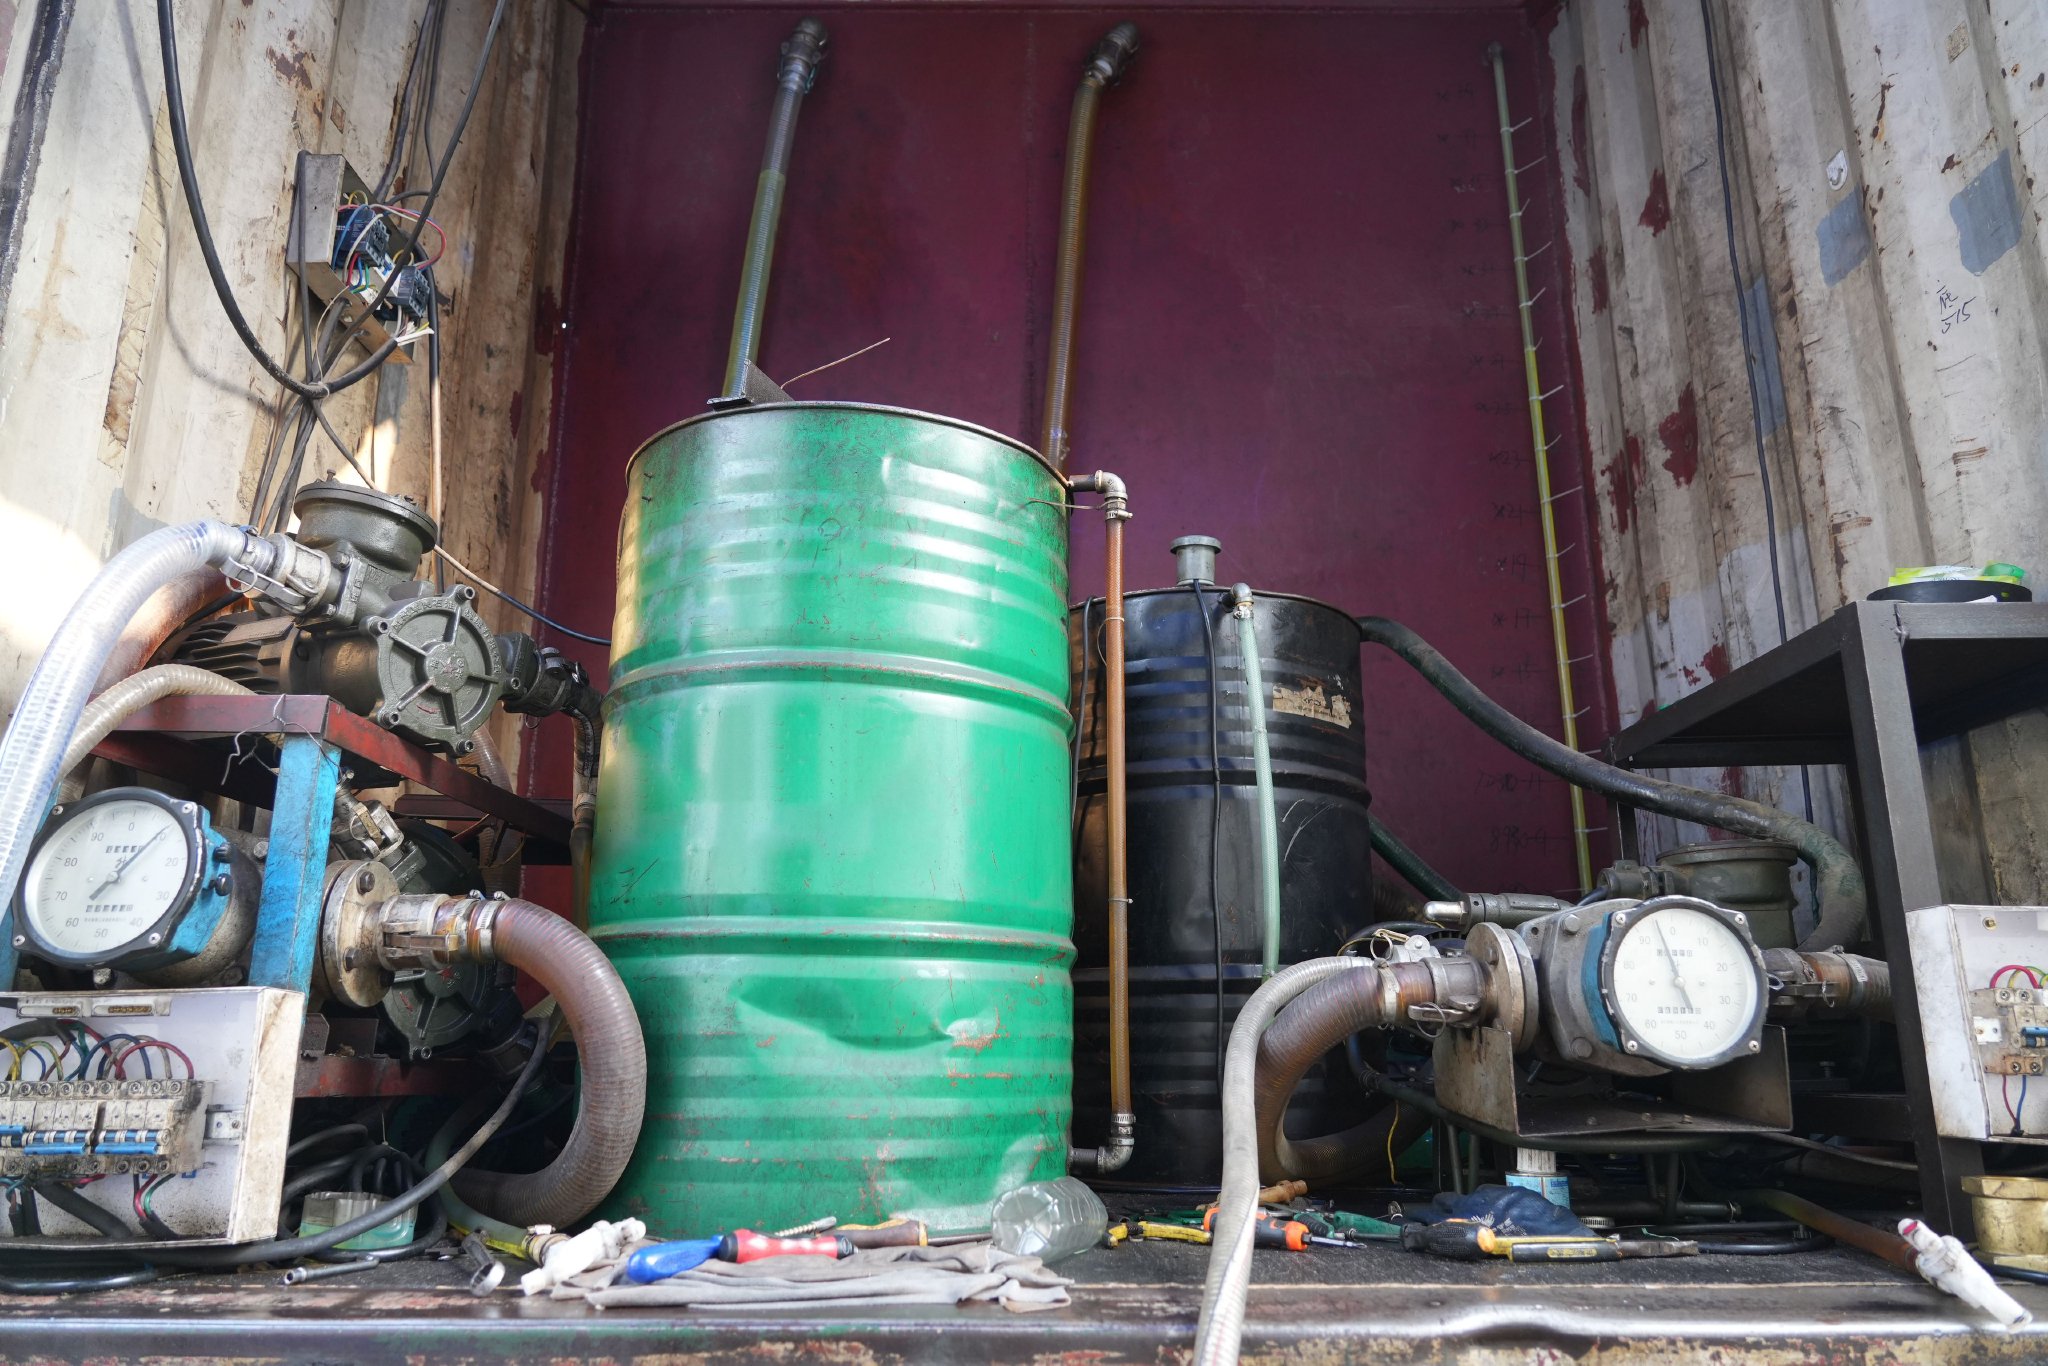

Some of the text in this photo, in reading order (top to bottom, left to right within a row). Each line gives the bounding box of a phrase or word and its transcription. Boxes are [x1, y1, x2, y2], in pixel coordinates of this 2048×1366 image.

[1941, 296, 1976, 334] 515
[90, 832, 105, 842] 90
[64, 857, 78, 867] 80
[165, 857, 179, 867] 20
[55, 891, 68, 901] 70
[156, 891, 170, 901] 30
[65, 917, 79, 928] 60
[129, 917, 143, 928] 40
[94, 928, 108, 938] 50
[1639, 936, 1651, 945] 90
[1697, 936, 1709, 945] 10
[1624, 961, 1635, 970] 80
[1716, 963, 1728, 972] 20
[1626, 993, 1638, 1002] 70
[1719, 995, 1731, 1005] 30
[1645, 1020, 1657, 1030] 60
[1703, 1020, 1716, 1030] 40
[1674, 1030, 1687, 1040] 50
